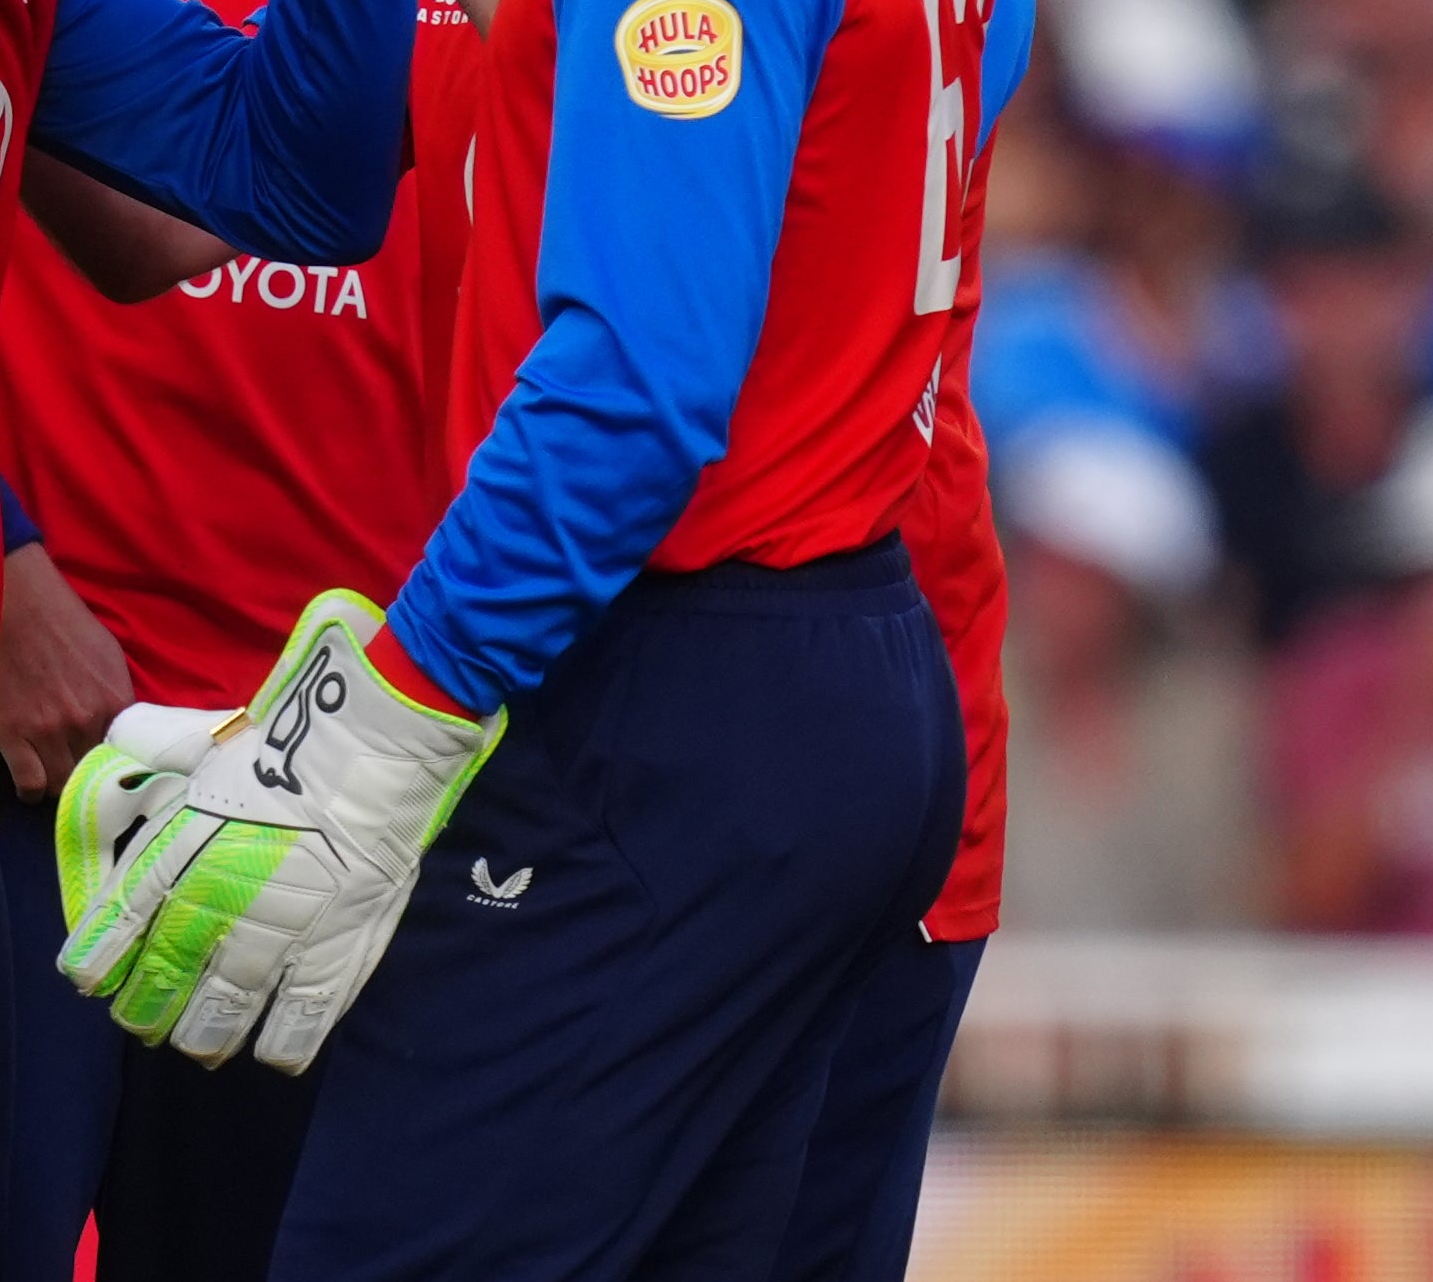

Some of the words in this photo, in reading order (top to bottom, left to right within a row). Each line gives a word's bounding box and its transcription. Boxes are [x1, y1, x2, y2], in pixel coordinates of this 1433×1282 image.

[638, 11, 719, 53] HULA
[637, 54, 729, 98] HOOPS
[177, 256, 367, 319] OYOTA
